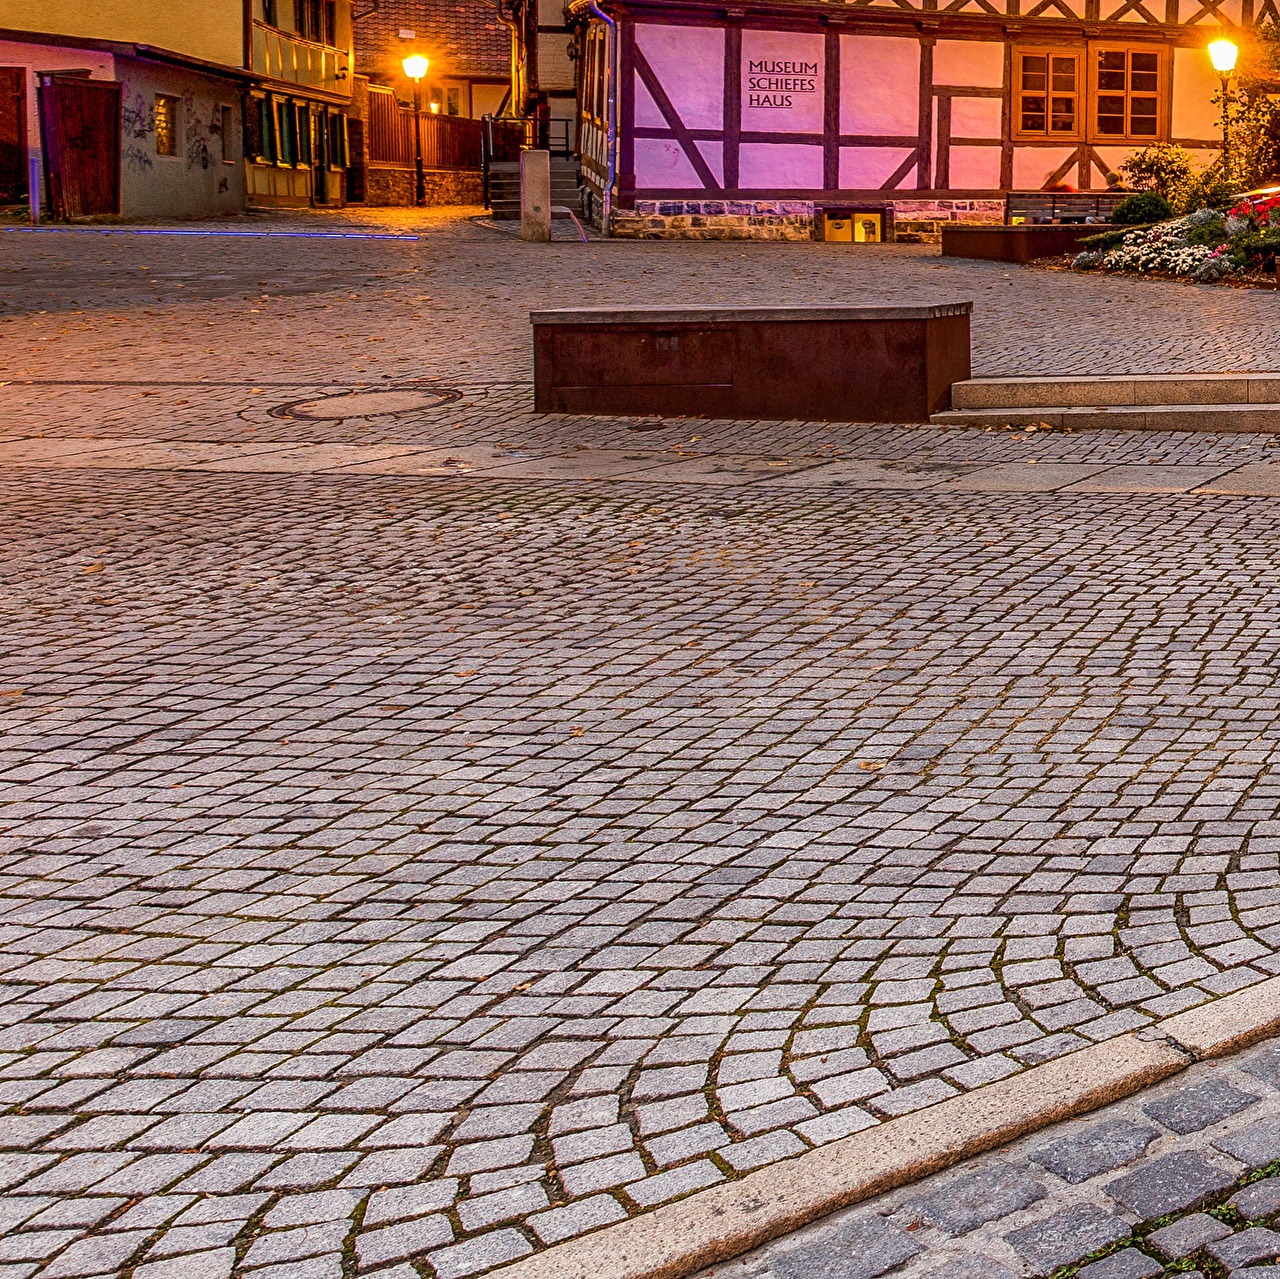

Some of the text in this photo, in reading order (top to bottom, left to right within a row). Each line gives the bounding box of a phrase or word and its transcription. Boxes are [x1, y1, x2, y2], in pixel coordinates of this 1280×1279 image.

[748, 60, 818, 74] MUSEUM
[748, 77, 815, 91] SCHIEFES
[748, 94, 792, 107] HAUS
